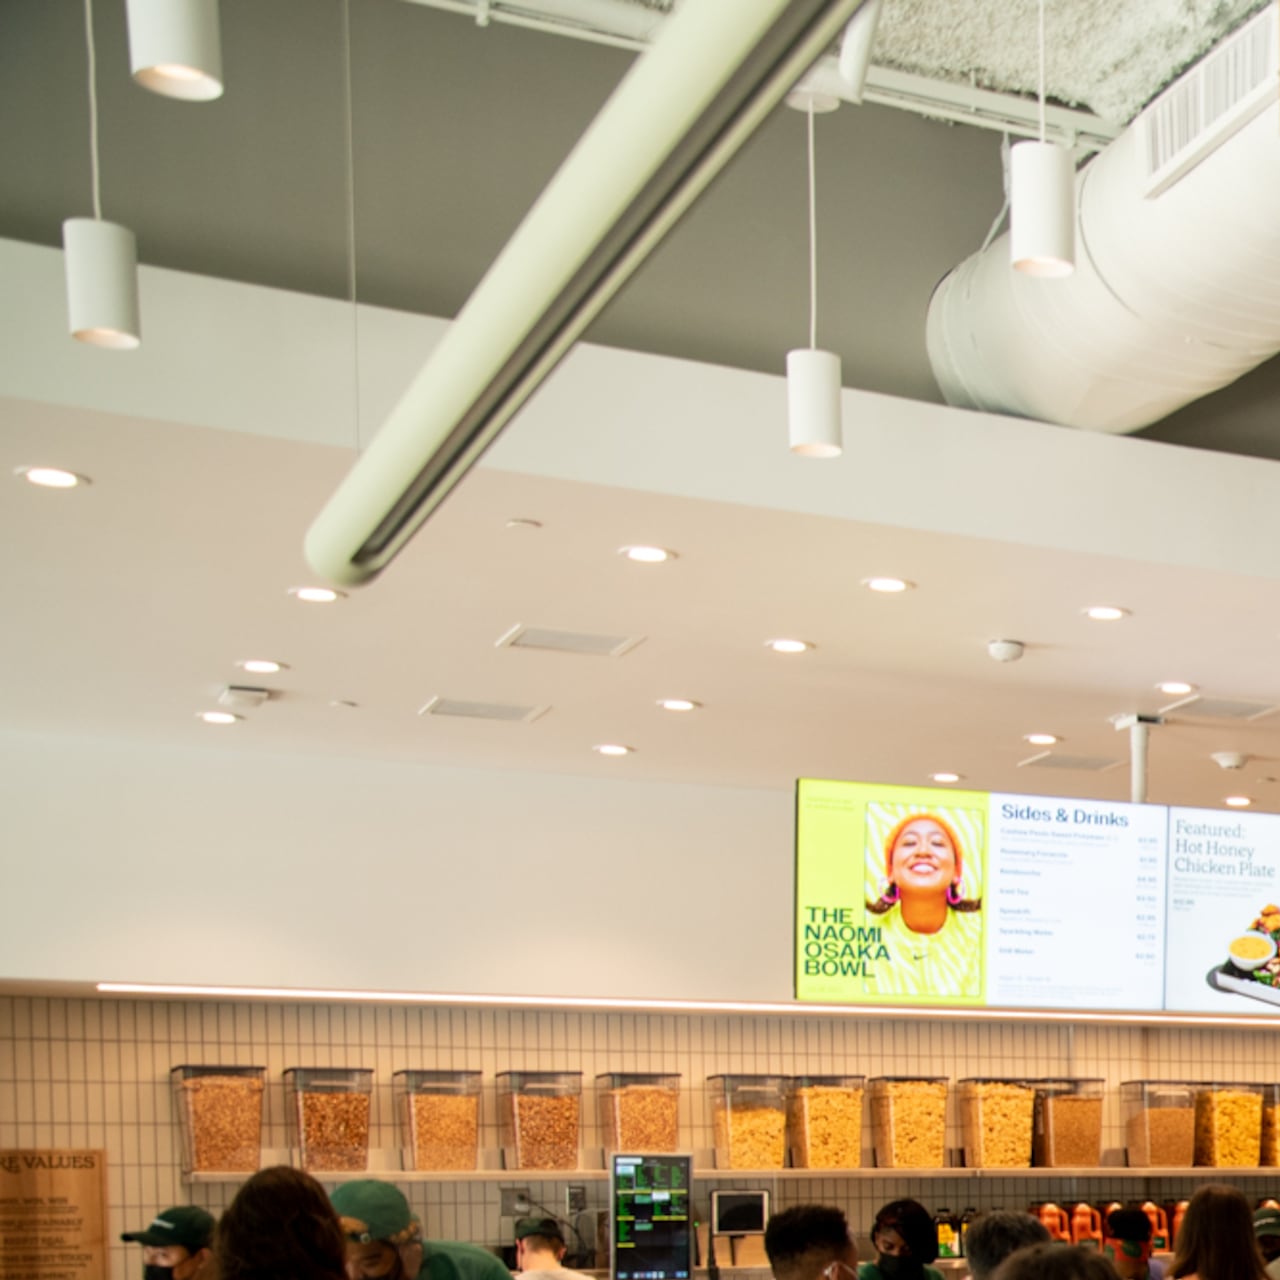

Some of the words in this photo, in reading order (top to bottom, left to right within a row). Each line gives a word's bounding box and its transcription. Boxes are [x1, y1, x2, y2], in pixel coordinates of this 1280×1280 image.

[1001, 804, 1051, 822] Sides
[1056, 808, 1068, 822] &
[1073, 809, 1129, 828] Drinks
[1175, 839, 1203, 855] Hot
[1206, 840, 1255, 861] Honey
[1174, 856, 1236, 876] Chicken
[1239, 862, 1275, 878] Plate
[805, 906, 853, 925] THE
[805, 924, 882, 943] NAOMI
[805, 941, 891, 960] OSAKA
[805, 959, 875, 978] BOWL
[23, 1156, 96, 1169] VALUES
